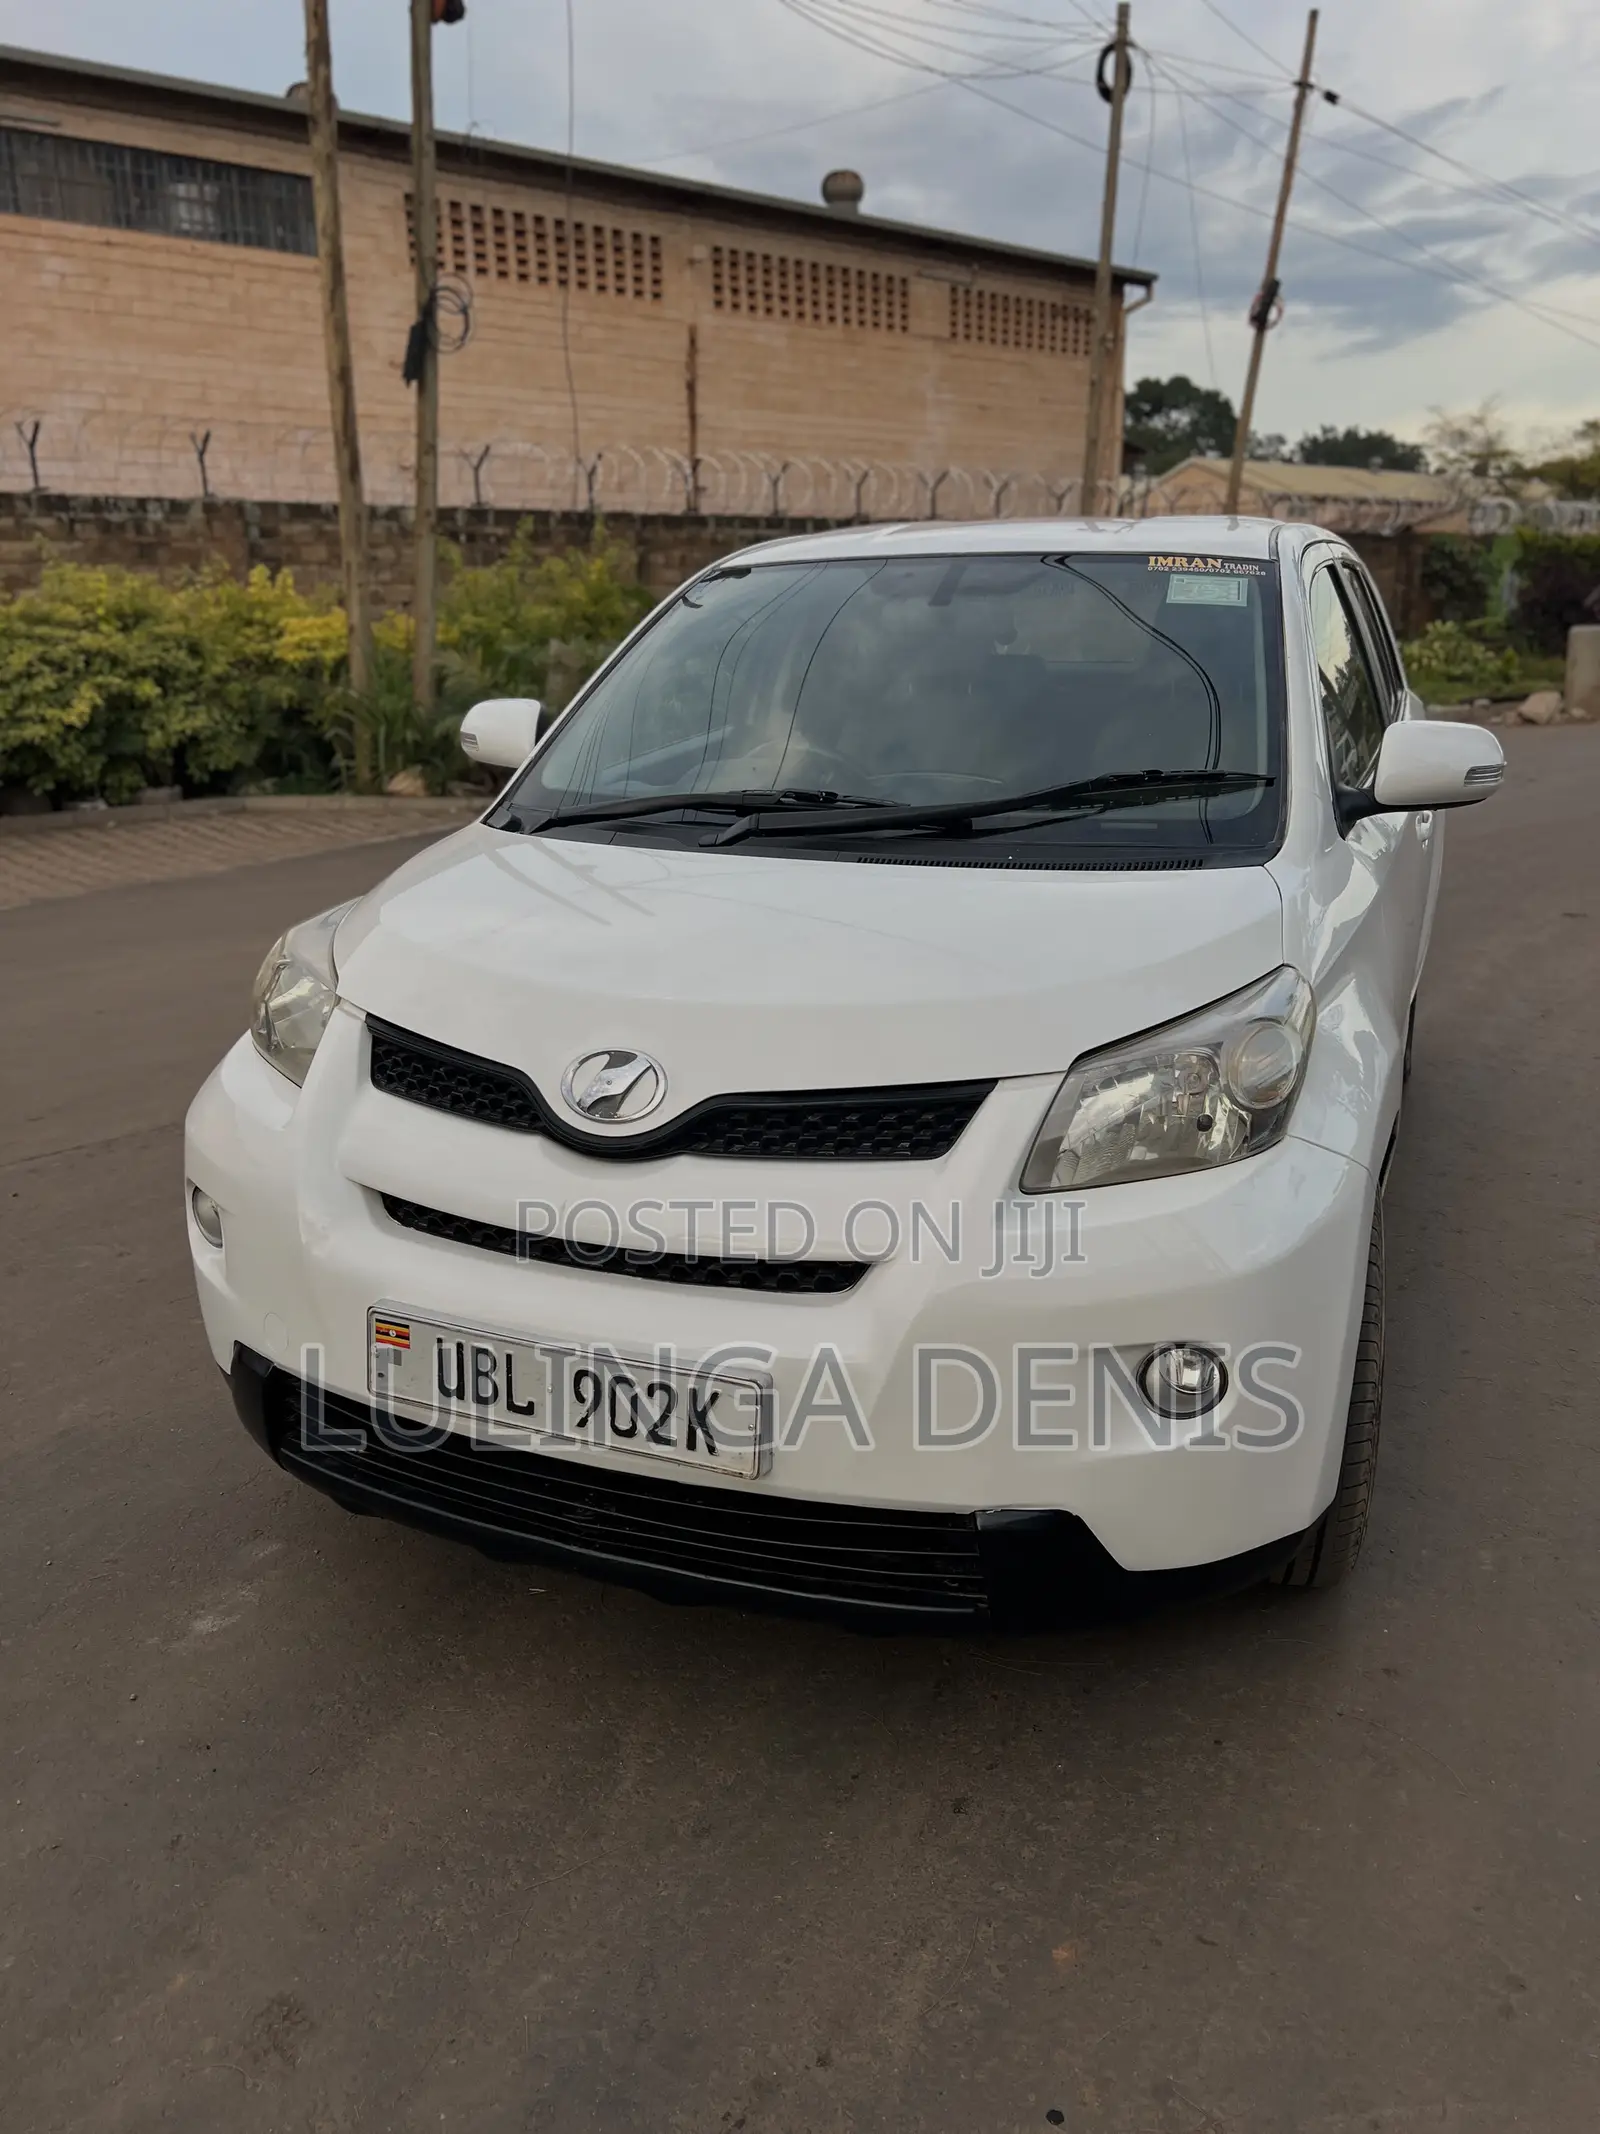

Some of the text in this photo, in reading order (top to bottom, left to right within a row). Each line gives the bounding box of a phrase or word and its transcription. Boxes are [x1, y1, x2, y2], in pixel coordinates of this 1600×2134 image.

[1148, 556, 1223, 568] IMRAN
[436, 1336, 724, 1456] UBL 902K
